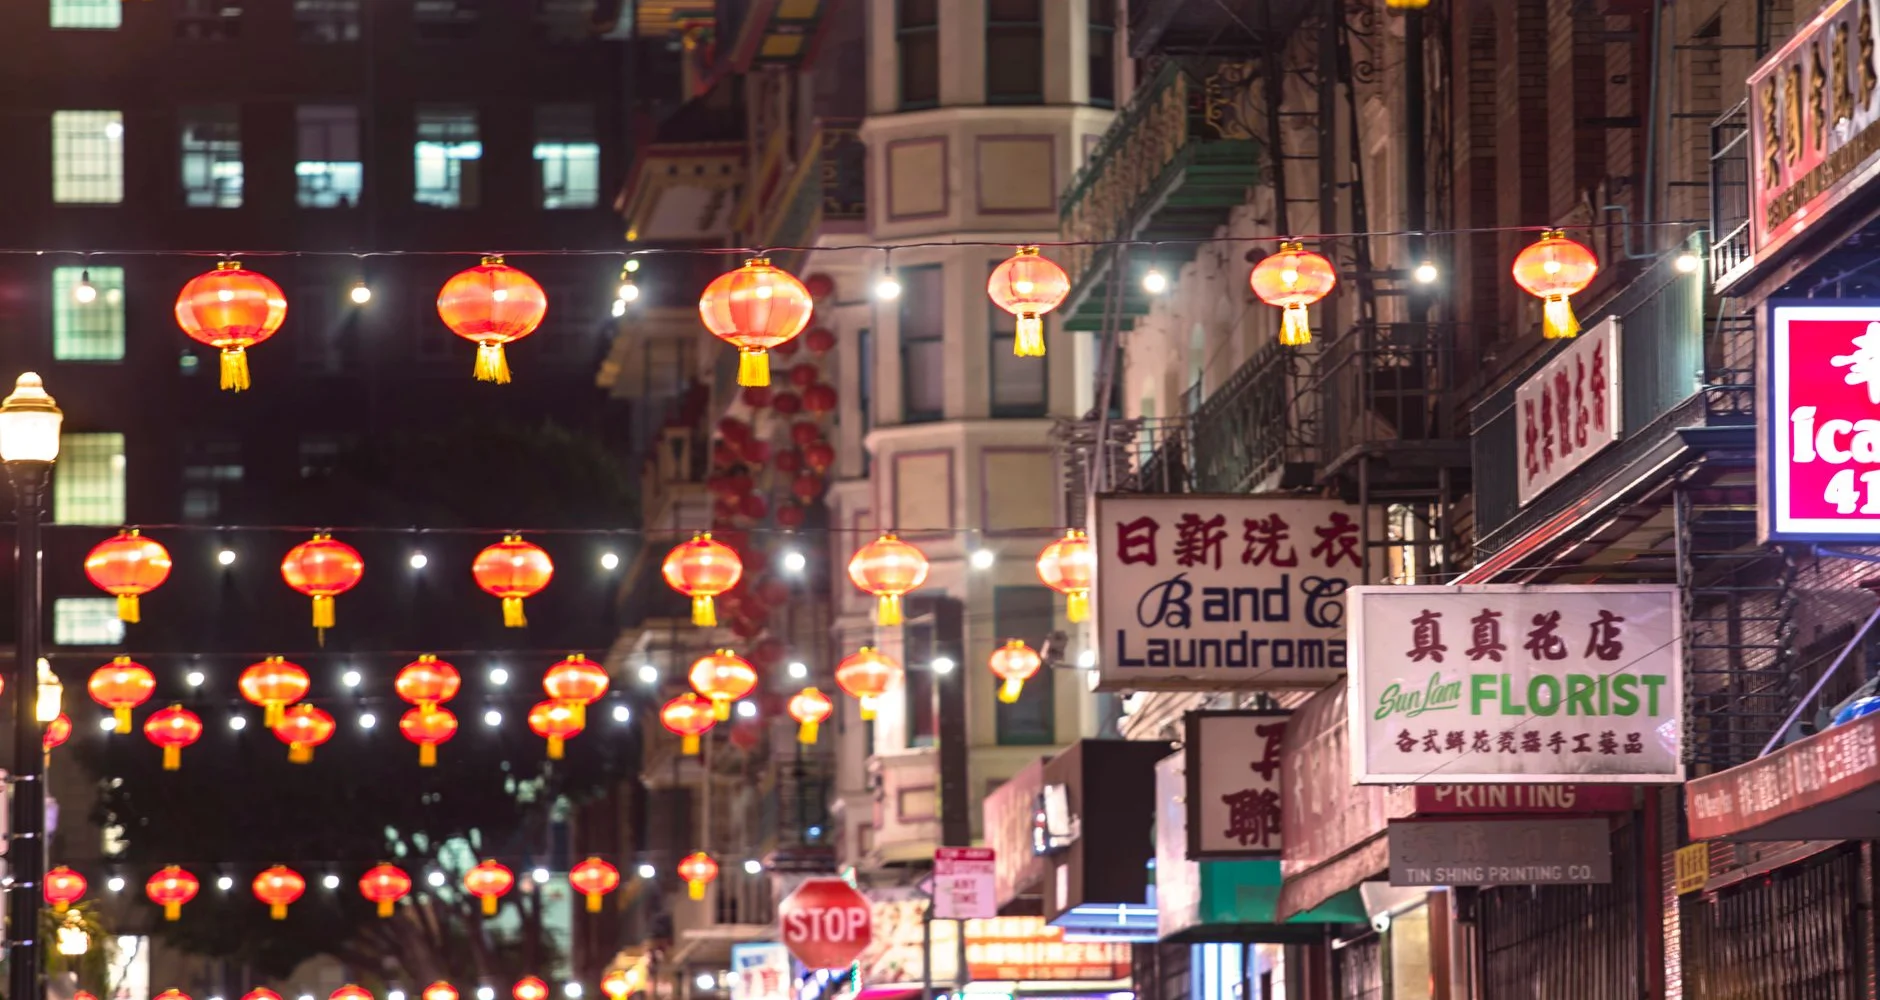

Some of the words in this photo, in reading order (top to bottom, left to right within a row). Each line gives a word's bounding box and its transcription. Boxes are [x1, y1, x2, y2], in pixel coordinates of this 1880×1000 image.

[1116, 511, 1363, 571] 日新洗衣
[1137, 572, 1193, 629] B
[1202, 573, 1291, 622] and
[1117, 629, 1347, 668] Laundroma
[1406, 608, 1625, 663] 真真花店
[1470, 673, 1667, 717] FLORIST
[1434, 785, 1577, 809] PRINTING
[1406, 868, 1432, 883] TIN
[1435, 867, 1484, 882] SHING
[1489, 866, 1562, 882] PRINTING
[1568, 865, 1595, 880] CO.
[787, 906, 867, 942] STOP
